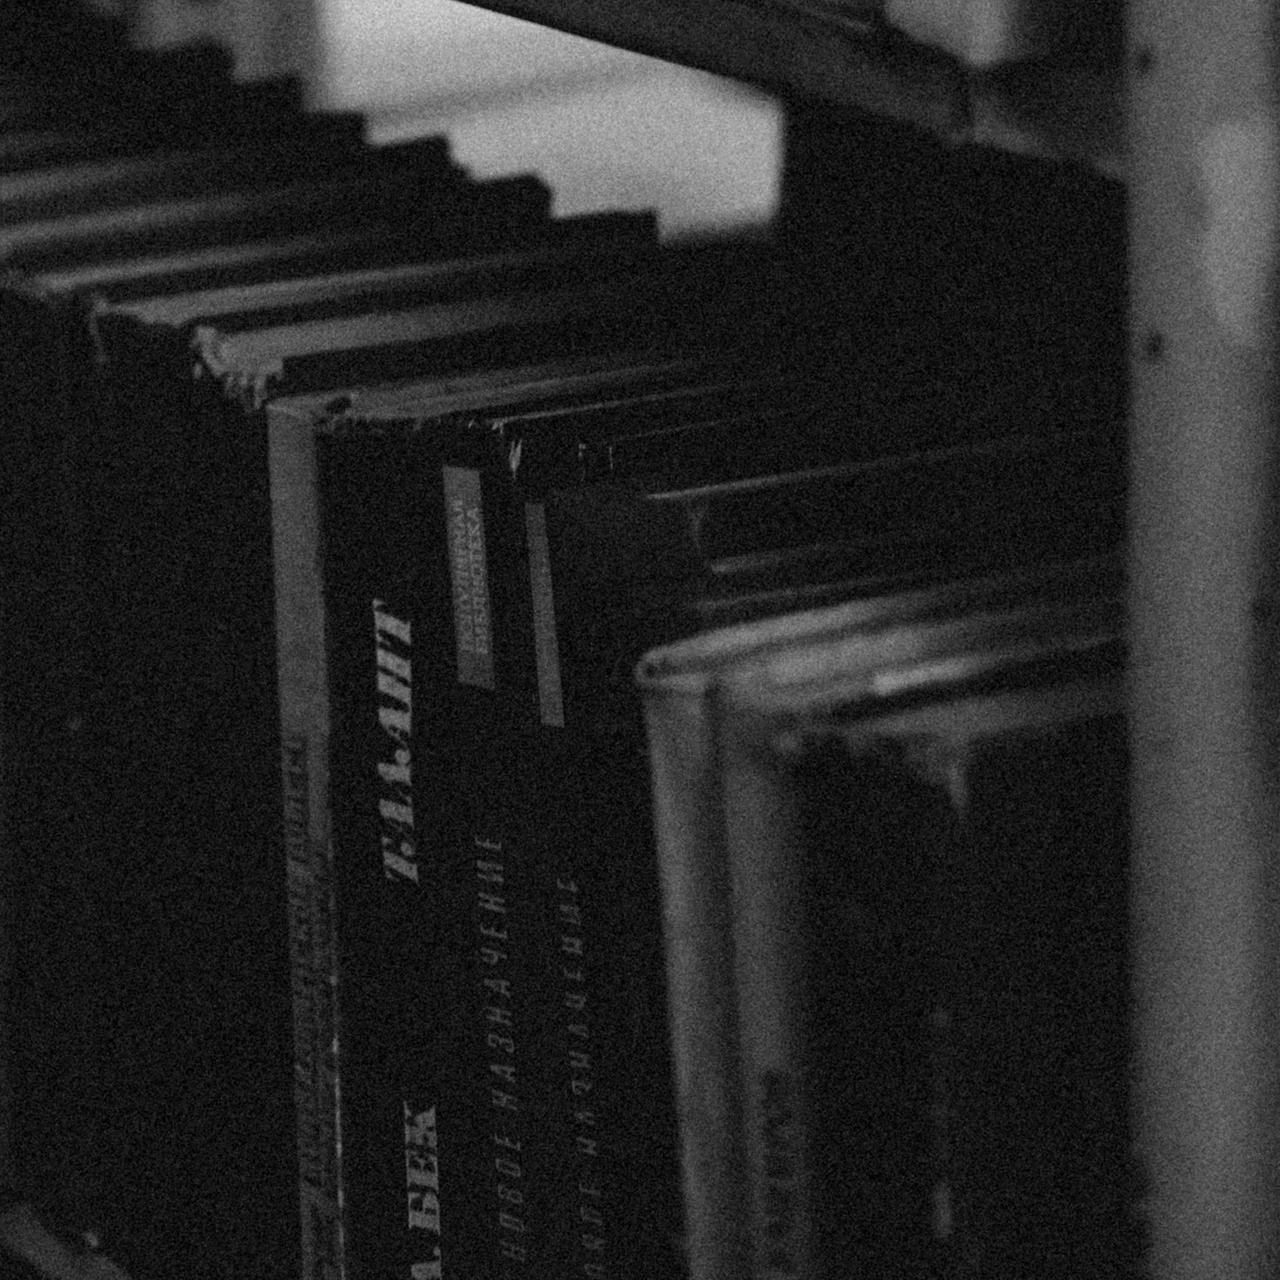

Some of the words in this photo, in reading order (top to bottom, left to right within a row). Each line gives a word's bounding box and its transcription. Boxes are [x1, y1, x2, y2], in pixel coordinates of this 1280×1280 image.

[475, 834, 521, 1112] НАЗНАЧЕНИЕ
[401, 1098, 444, 1236] БЕК
[493, 1130, 528, 1264] НОВОЕ
